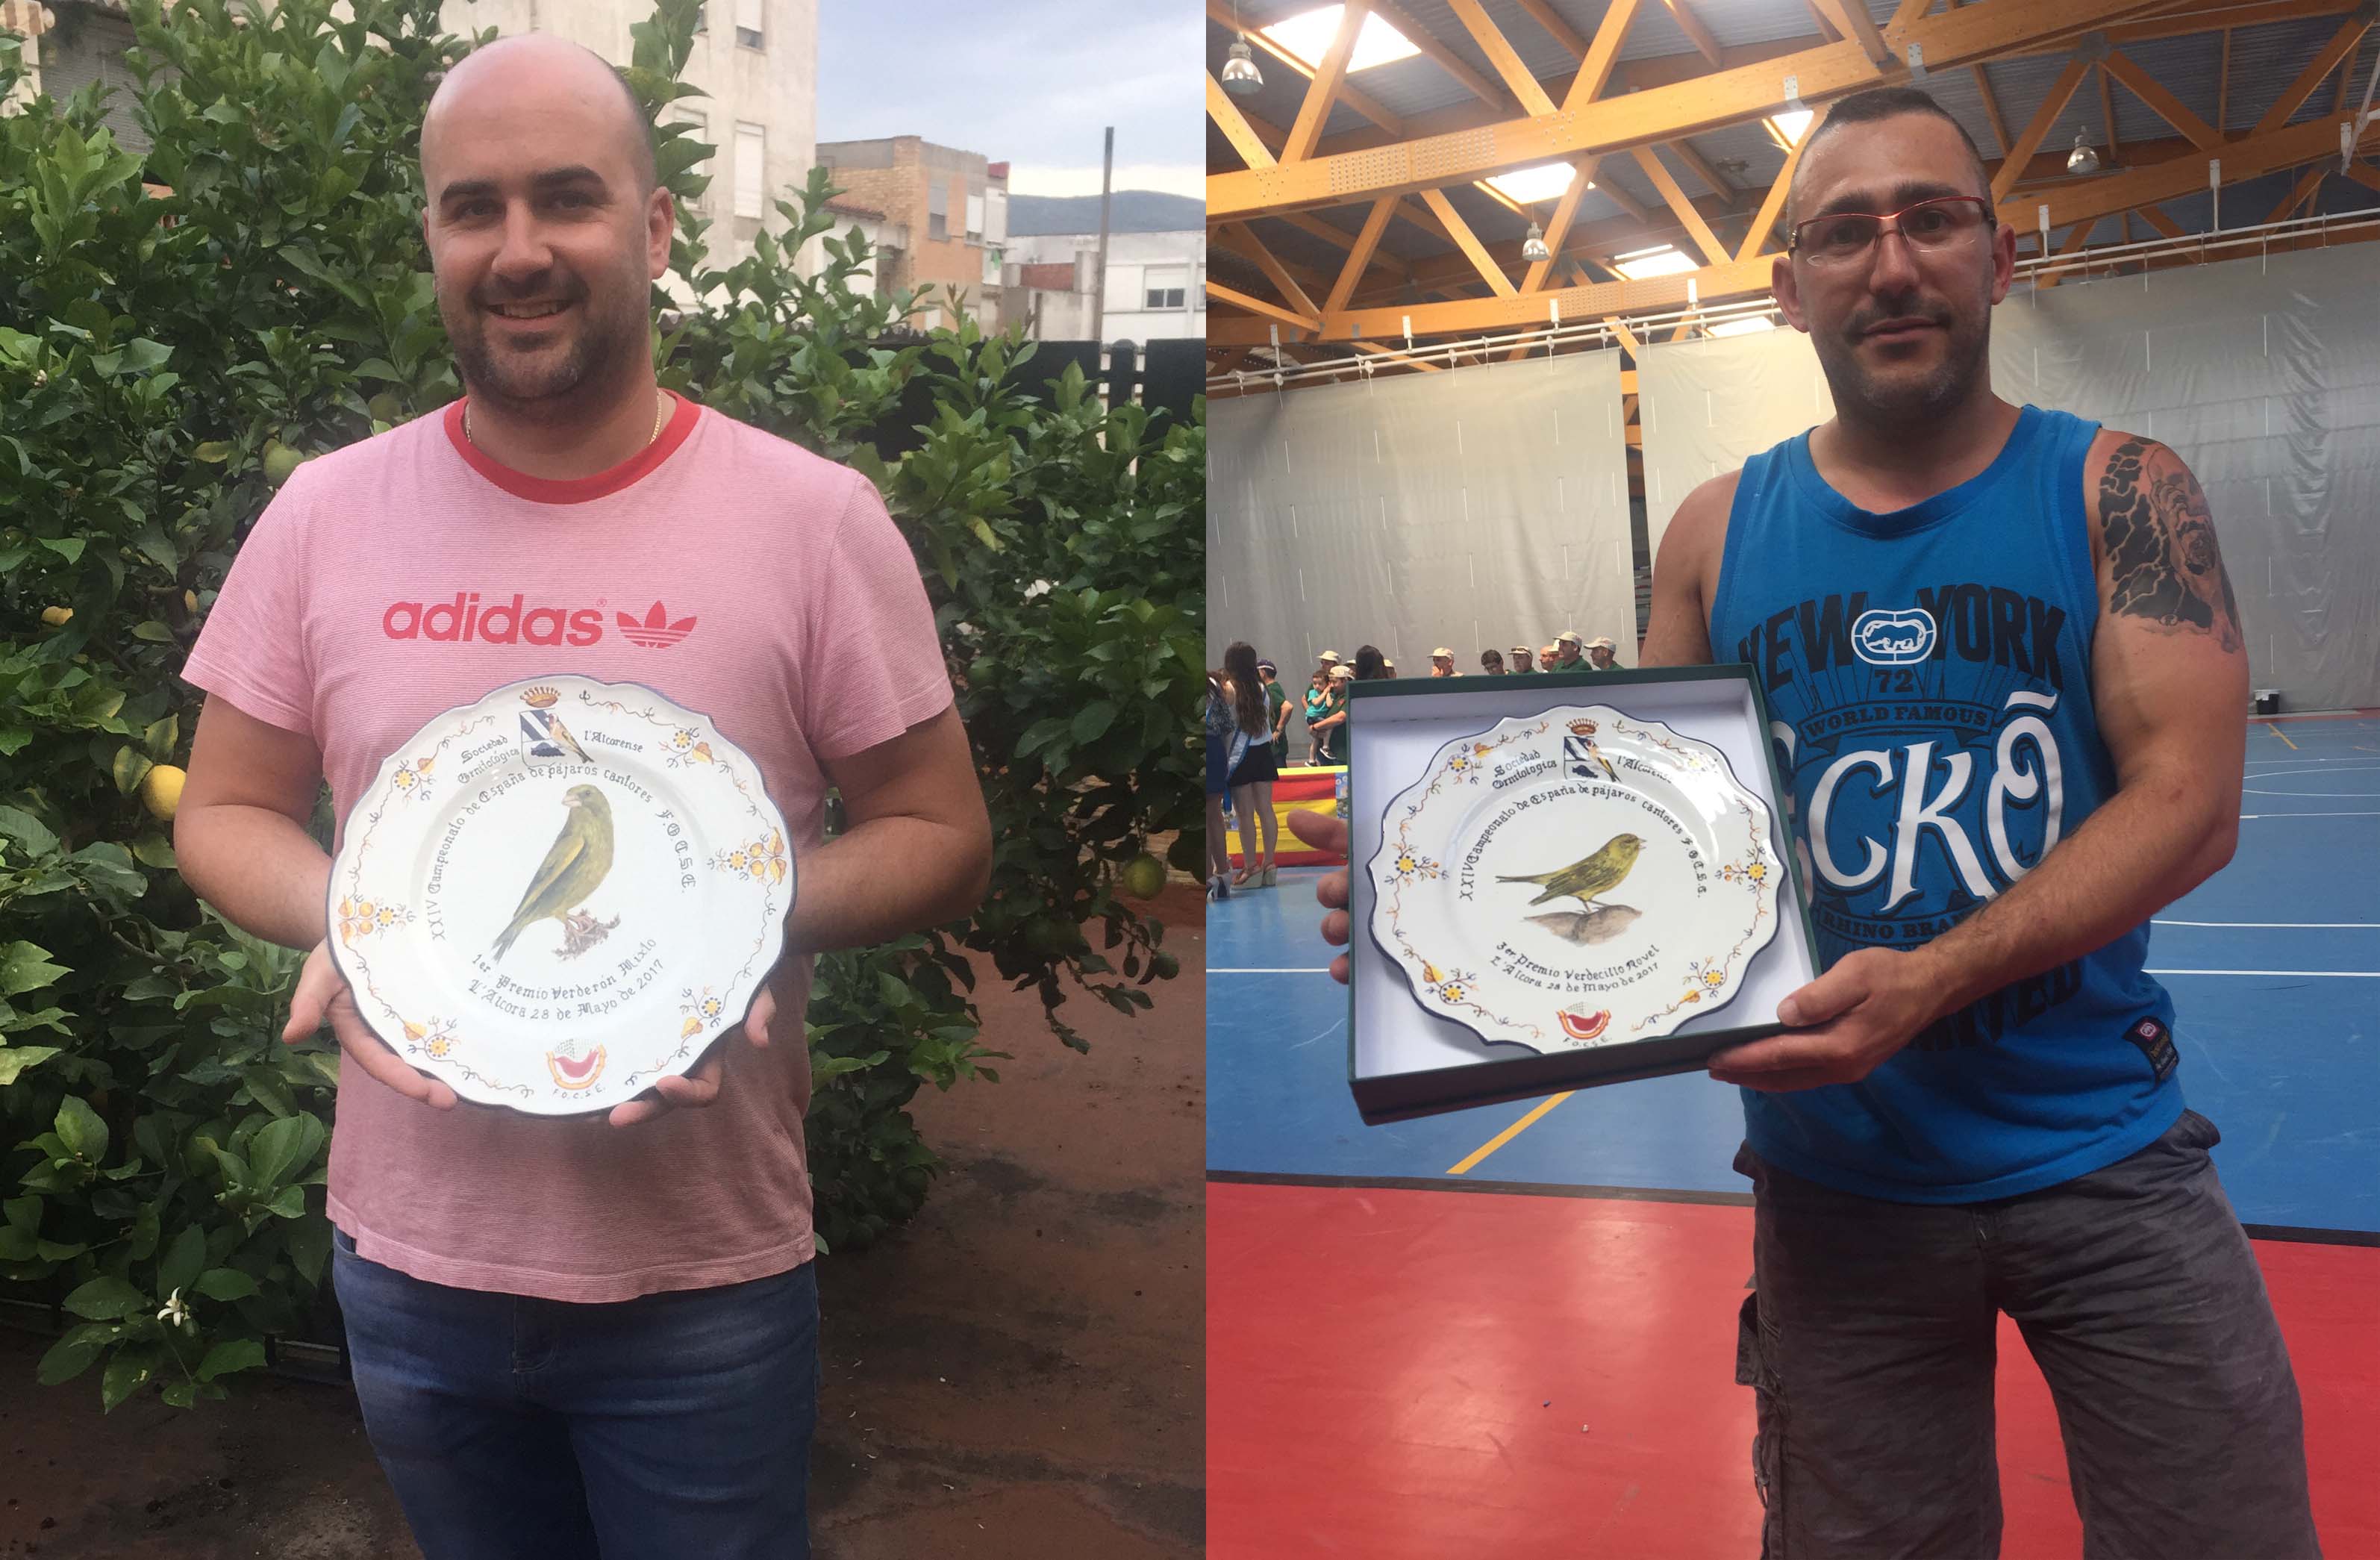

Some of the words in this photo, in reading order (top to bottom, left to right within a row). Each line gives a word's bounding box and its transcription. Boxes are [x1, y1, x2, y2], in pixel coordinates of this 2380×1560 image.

[383, 593, 604, 646] adidas
[1916, 583, 2066, 690] YORK
[1874, 670, 1914, 693] 72
[1805, 705, 1889, 738] WORLD
[1894, 703, 1987, 725] FAMOUS
[461, 734, 508, 763] Sociedad
[1494, 749, 1540, 778] Sociedad
[528, 767, 544, 778] de
[549, 763, 598, 779] pájaros
[604, 770, 653, 803] cantores
[478, 772, 525, 803] España
[1530, 786, 1576, 805] España
[1577, 783, 1590, 793] de
[460, 802, 481, 815] de
[1512, 801, 1530, 811] de
[1641, 801, 1683, 834] cantores
[1467, 808, 1516, 864] Campeonato
[428, 817, 465, 894] Campeonato
[1460, 862, 1475, 901] XXIV
[425, 899, 446, 941] XXIV
[1823, 913, 1894, 939] RHINO
[496, 974, 549, 999] Premio
[553, 974, 617, 999] Verderón
[618, 938, 657, 976] Mixto
[1515, 952, 1560, 979] Premio
[1564, 968, 1625, 981] Verdecillo
[1626, 944, 1660, 971] Novel
[1546, 982, 1561, 990] 28
[1567, 979, 1580, 992] de
[1583, 982, 1620, 993] Mayo
[1620, 973, 1635, 987] de
[1637, 962, 1659, 980] 2017
[469, 979, 526, 1017] L'Alcora
[530, 1009, 550, 1020] 28
[557, 1008, 572, 1020] de
[577, 999, 618, 1017] Mayo
[618, 987, 636, 1001] de
[637, 958, 664, 990] 2017
